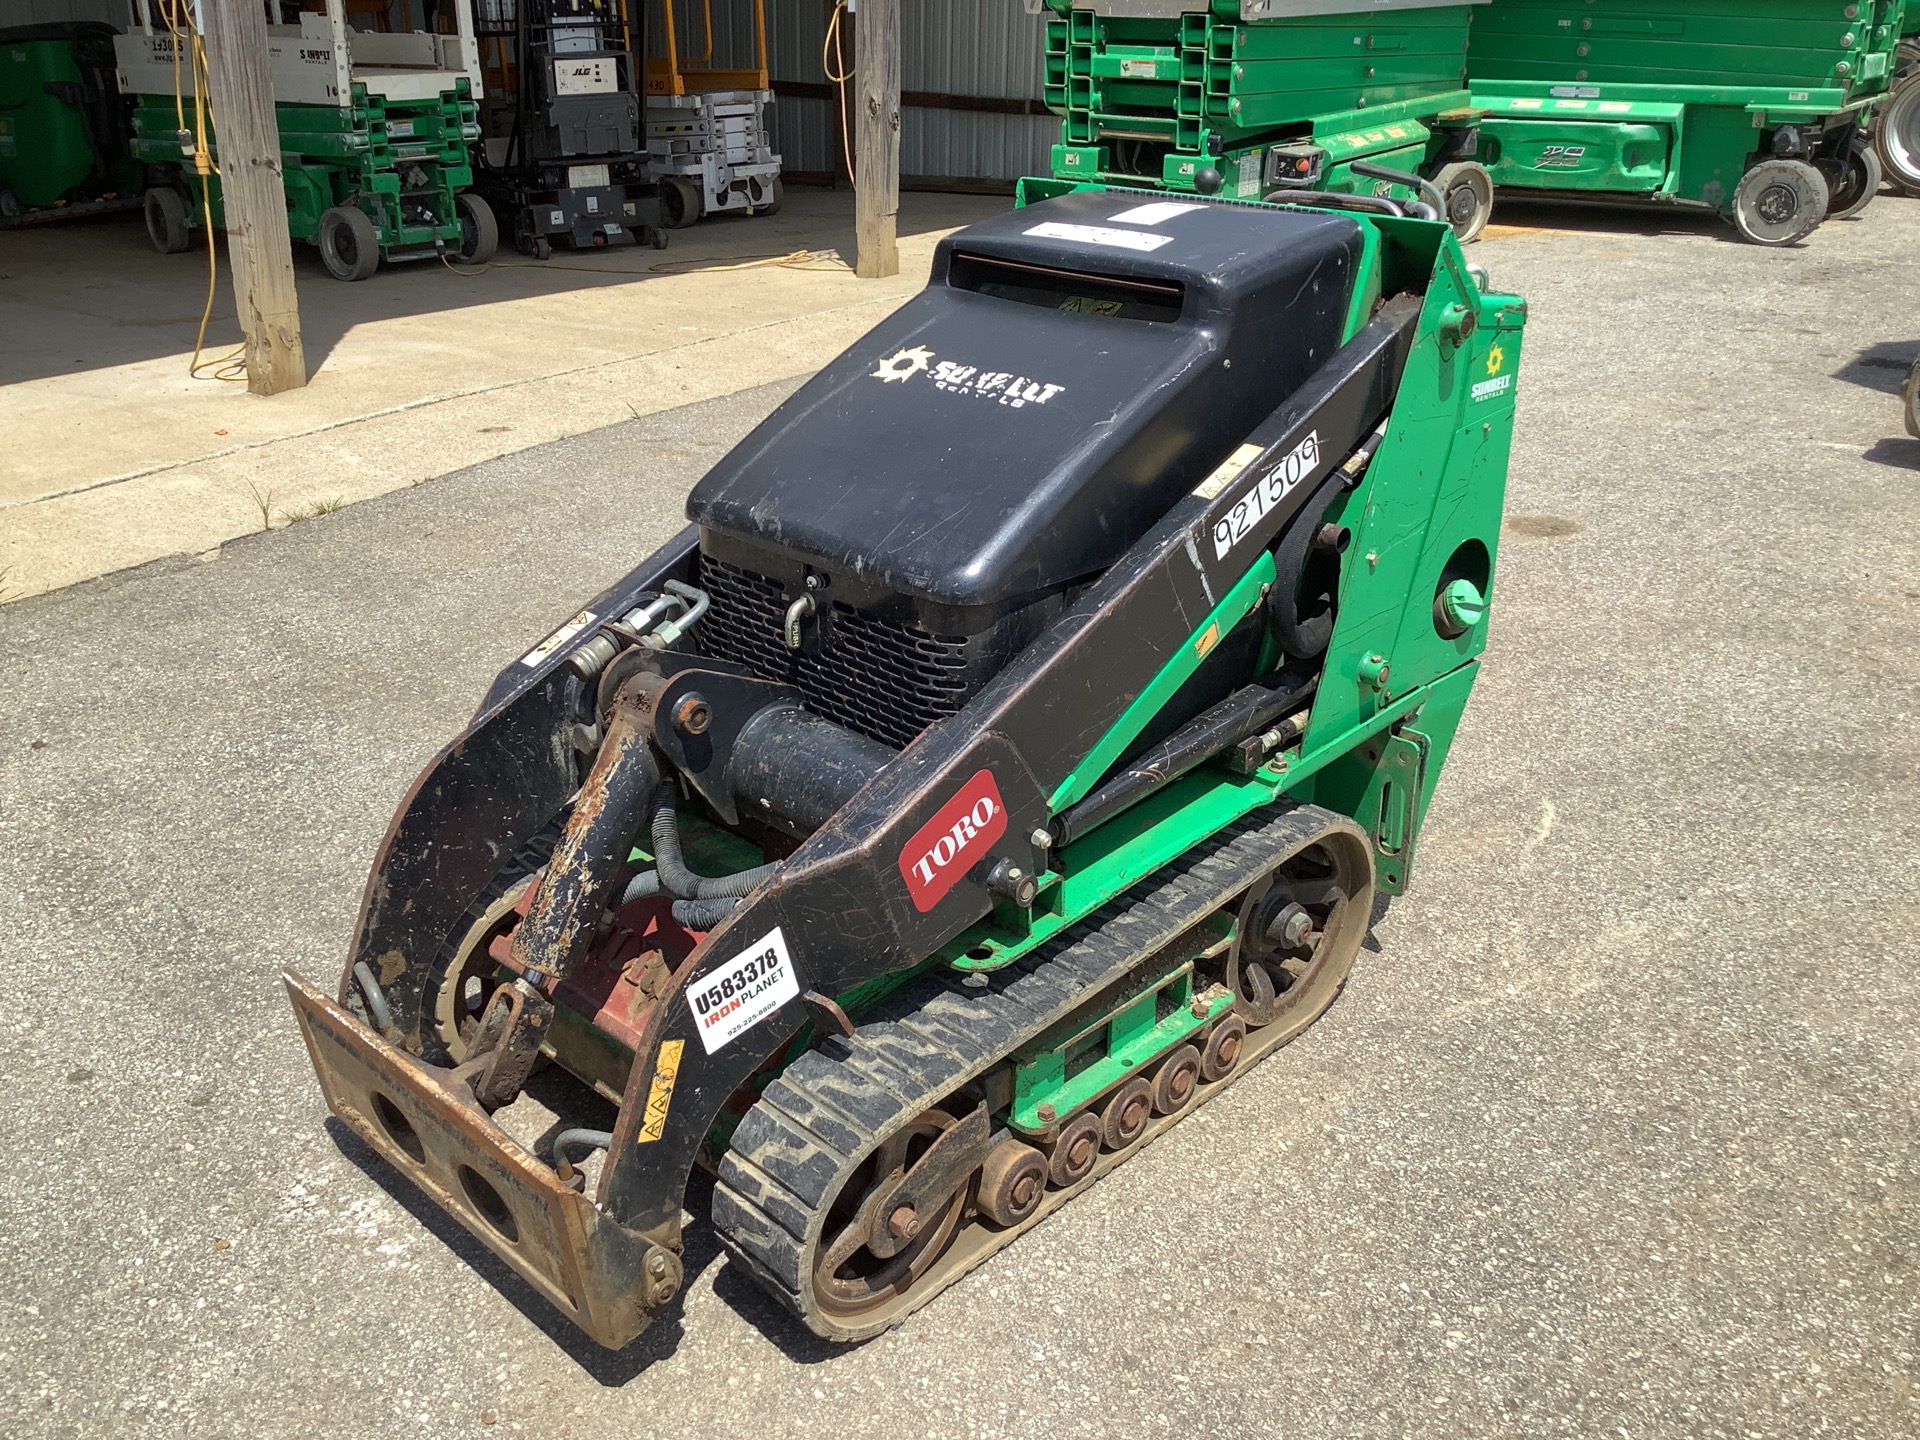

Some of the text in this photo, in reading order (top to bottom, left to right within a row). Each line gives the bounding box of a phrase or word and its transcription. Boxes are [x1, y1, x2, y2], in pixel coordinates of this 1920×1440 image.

[153, 39, 184, 51] 1930S
[572, 68, 591, 76] JLG
[1471, 374, 1511, 398] SUNBELT
[1475, 389, 1504, 403] RENTALS
[1215, 436, 1319, 545] 921509
[911, 797, 994, 887] TORO
[694, 947, 779, 1015] U583378
[727, 1000, 777, 1036] 925-225-8800
